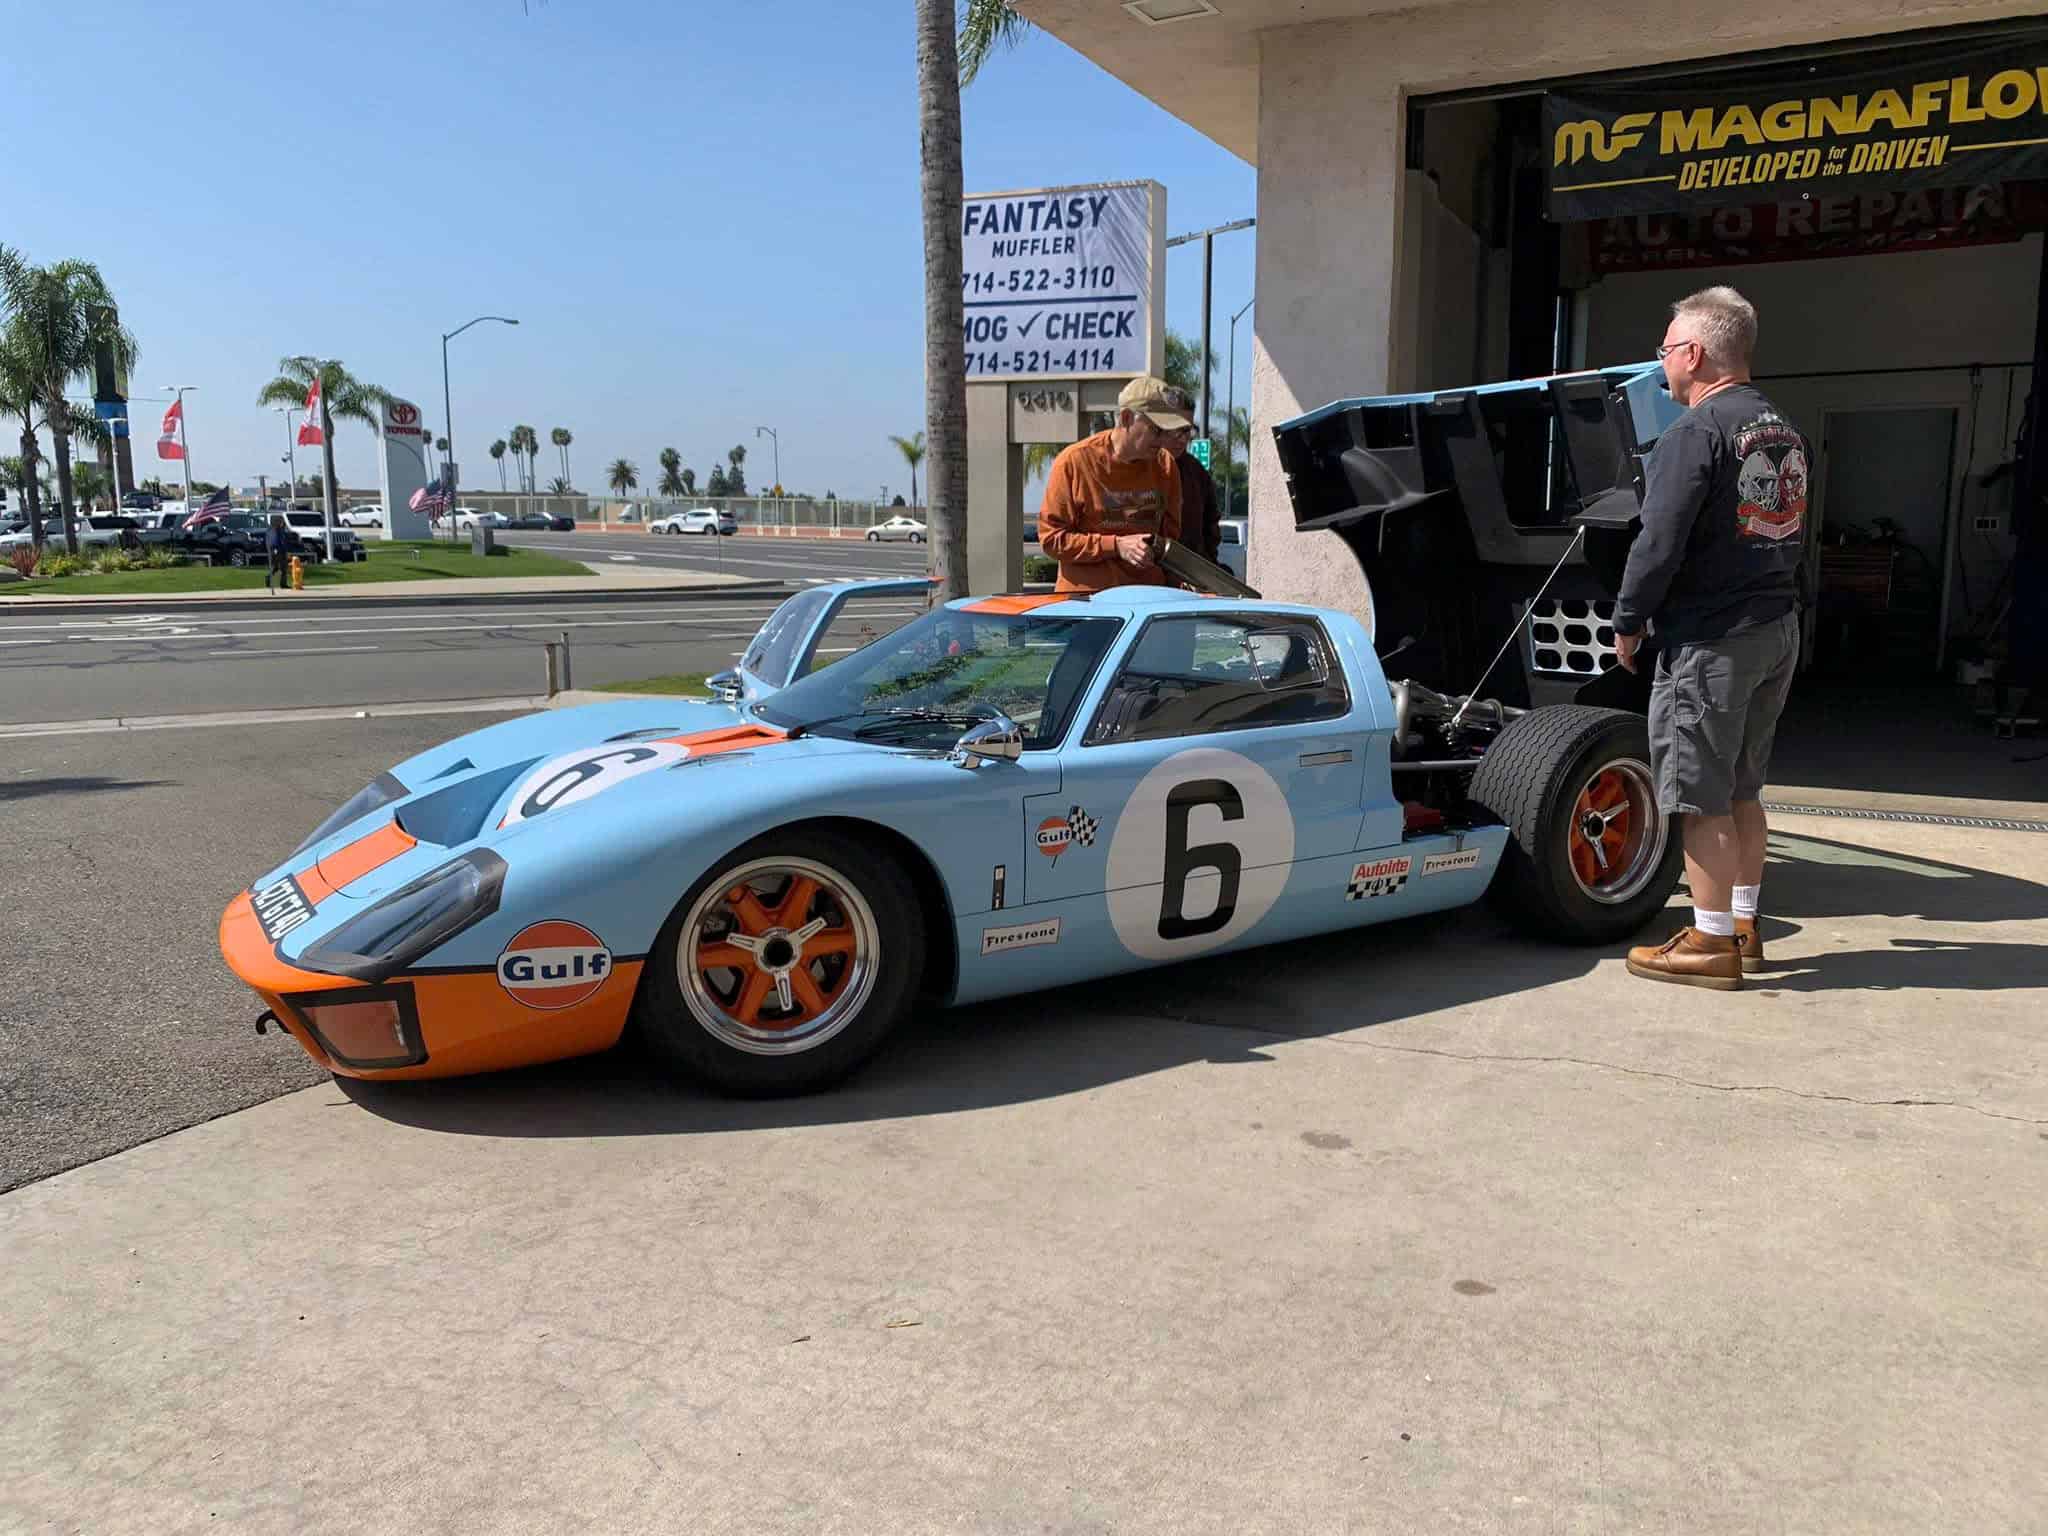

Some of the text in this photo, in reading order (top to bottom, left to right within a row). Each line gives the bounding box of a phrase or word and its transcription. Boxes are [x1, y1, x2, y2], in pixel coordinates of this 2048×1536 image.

[1678, 135, 1950, 191] DEVELOPED for the DRIVEN
[963, 196, 1109, 236] FANTASY
[992, 236, 1075, 258] MUFFLER
[962, 265, 1115, 293] 714-522-3110
[1045, 310, 1136, 339] CHECK
[964, 348, 1115, 375] 714-521-4114
[521, 748, 658, 818] 6
[1037, 829, 1070, 844] Gulf
[1158, 779, 1244, 940] 6
[1355, 860, 1409, 879] Autolite
[1426, 855, 1477, 871] Firestone
[985, 927, 1056, 948] Firestone
[503, 953, 607, 981] Gulf
